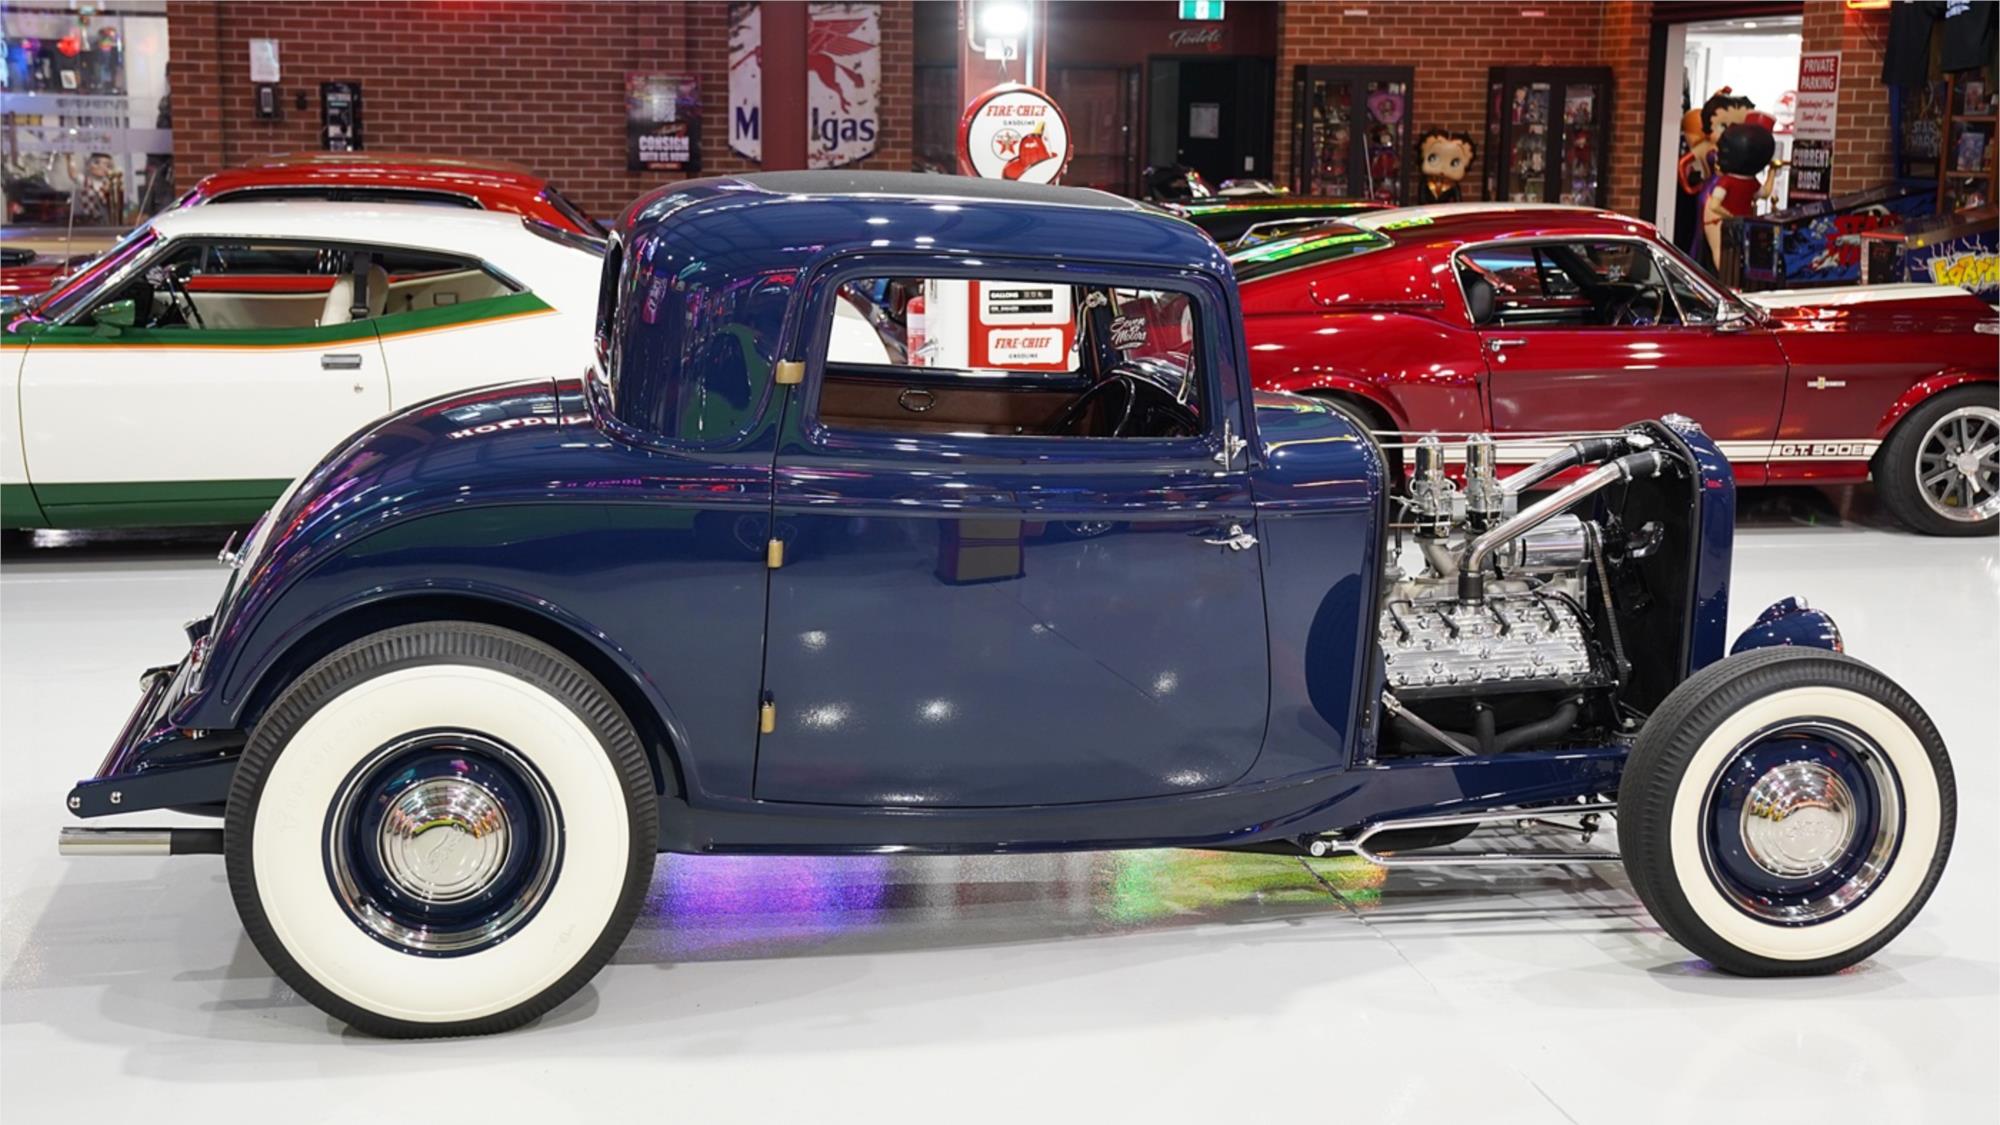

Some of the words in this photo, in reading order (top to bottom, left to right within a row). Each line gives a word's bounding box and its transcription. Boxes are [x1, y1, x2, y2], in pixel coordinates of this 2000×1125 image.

[1803, 58, 1835, 73] PRIVATE
[1800, 74, 1834, 90] PARKING
[735, 106, 875, 150] Mlgas
[639, 135, 689, 151] CONSIGN
[1793, 148, 1830, 168] CURRENT
[1797, 170, 1821, 190] BIDS!
[994, 337, 1052, 349] FIRE-CHIEF
[1781, 444, 1809, 456] G.T.
[1811, 443, 1865, 456] 500E
